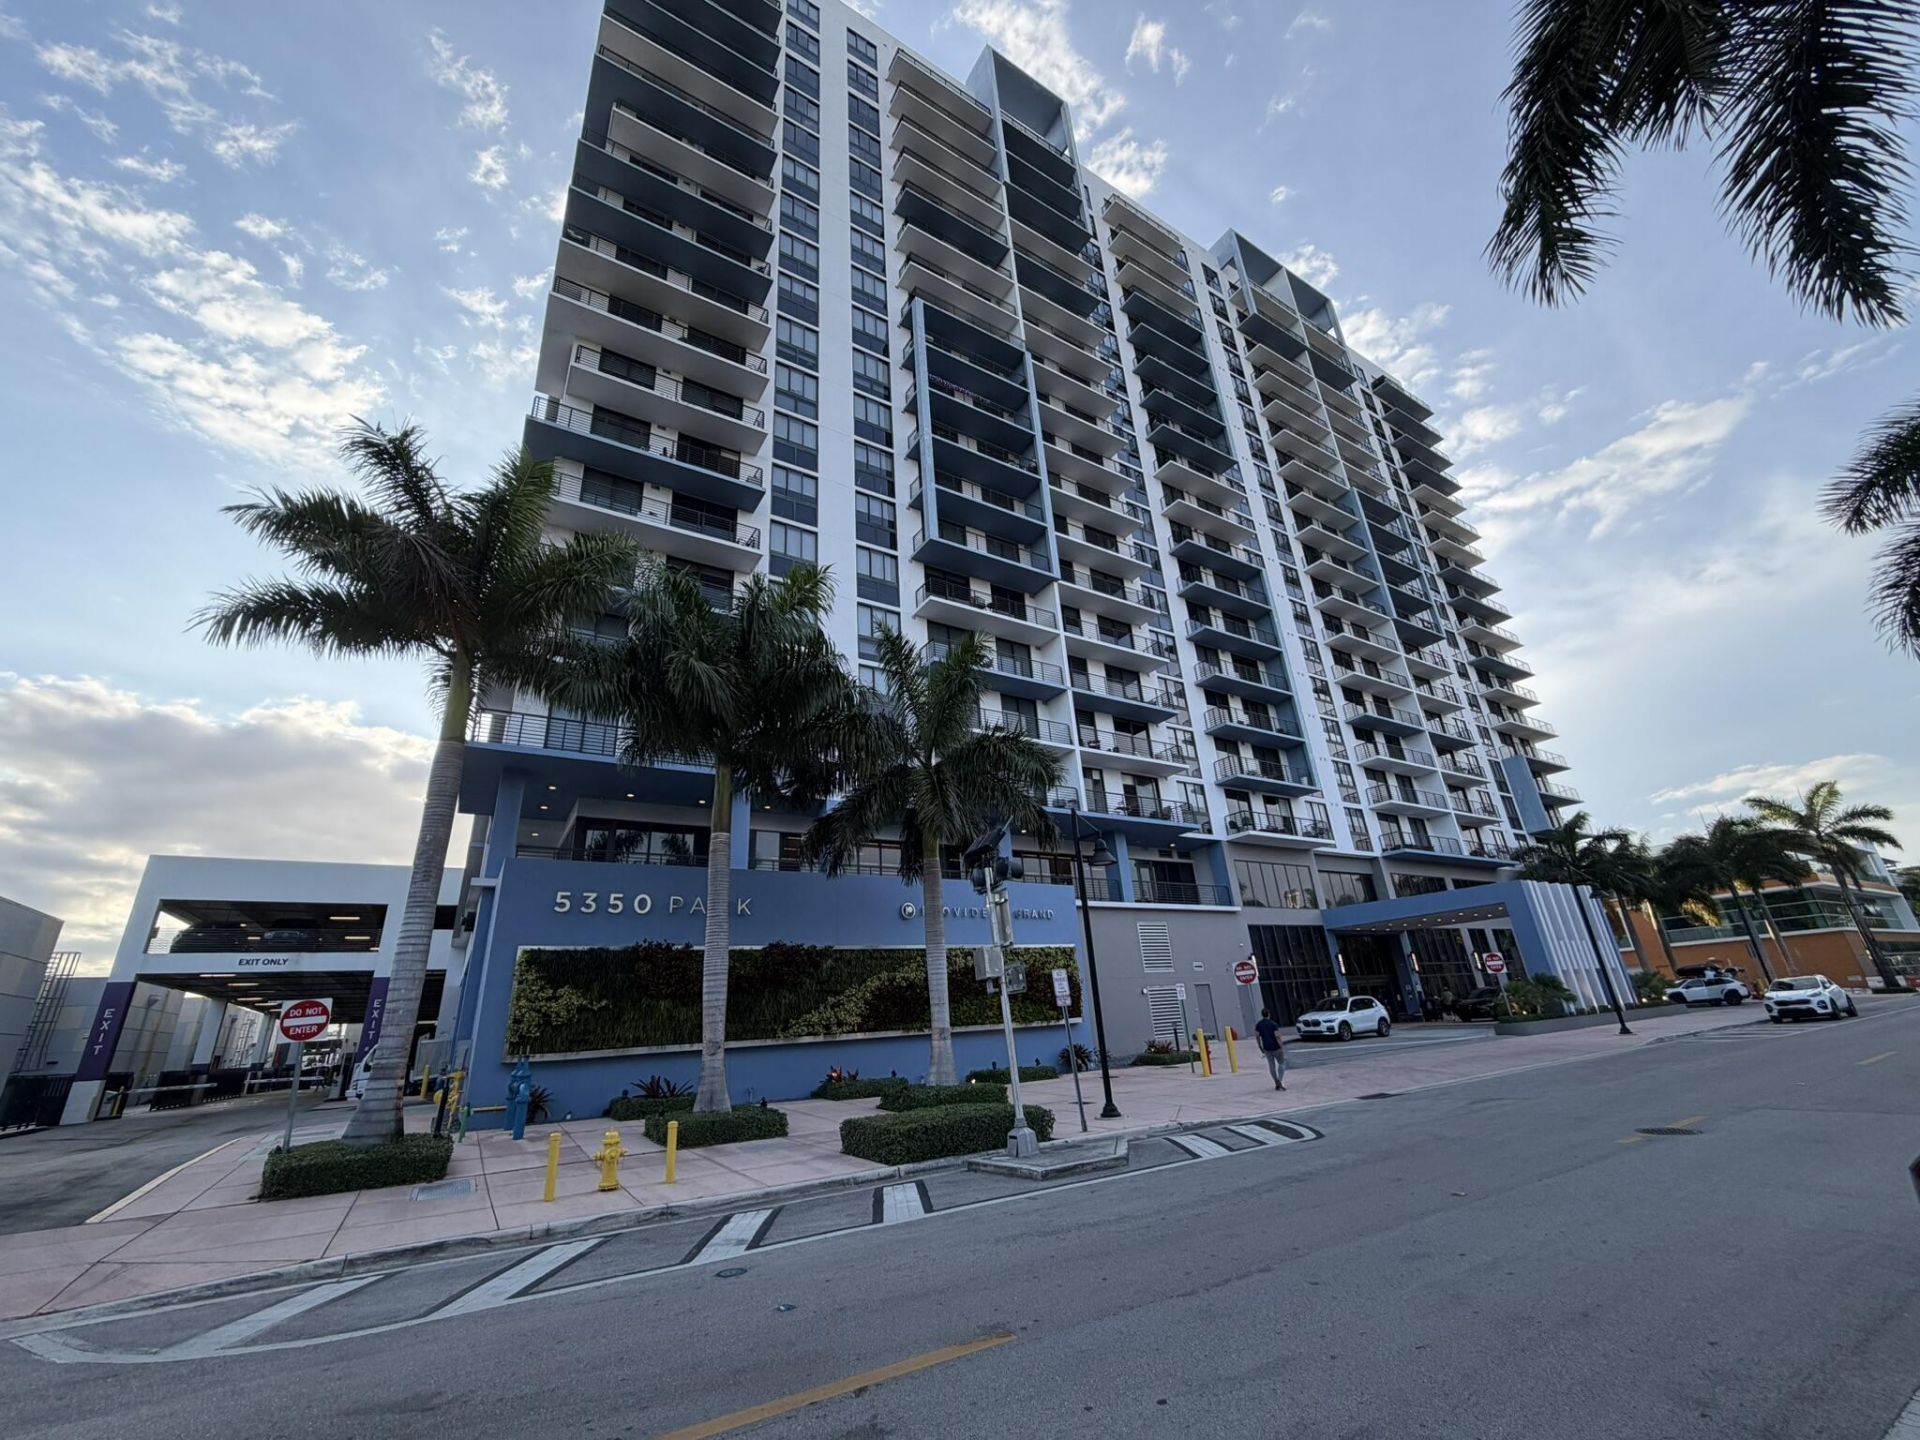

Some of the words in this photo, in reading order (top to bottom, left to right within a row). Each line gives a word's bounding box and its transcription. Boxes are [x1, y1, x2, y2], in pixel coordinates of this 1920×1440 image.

[554, 891, 652, 914] 5350
[669, 896, 751, 915] PAK
[238, 958, 261, 966] EXIT
[262, 958, 289, 966] ONLY
[290, 1008, 303, 1017] DO
[305, 1006, 323, 1015] NOT
[367, 999, 383, 1040] EXIT
[93, 1008, 116, 1055] EXIT
[290, 1024, 318, 1035] ENTER
